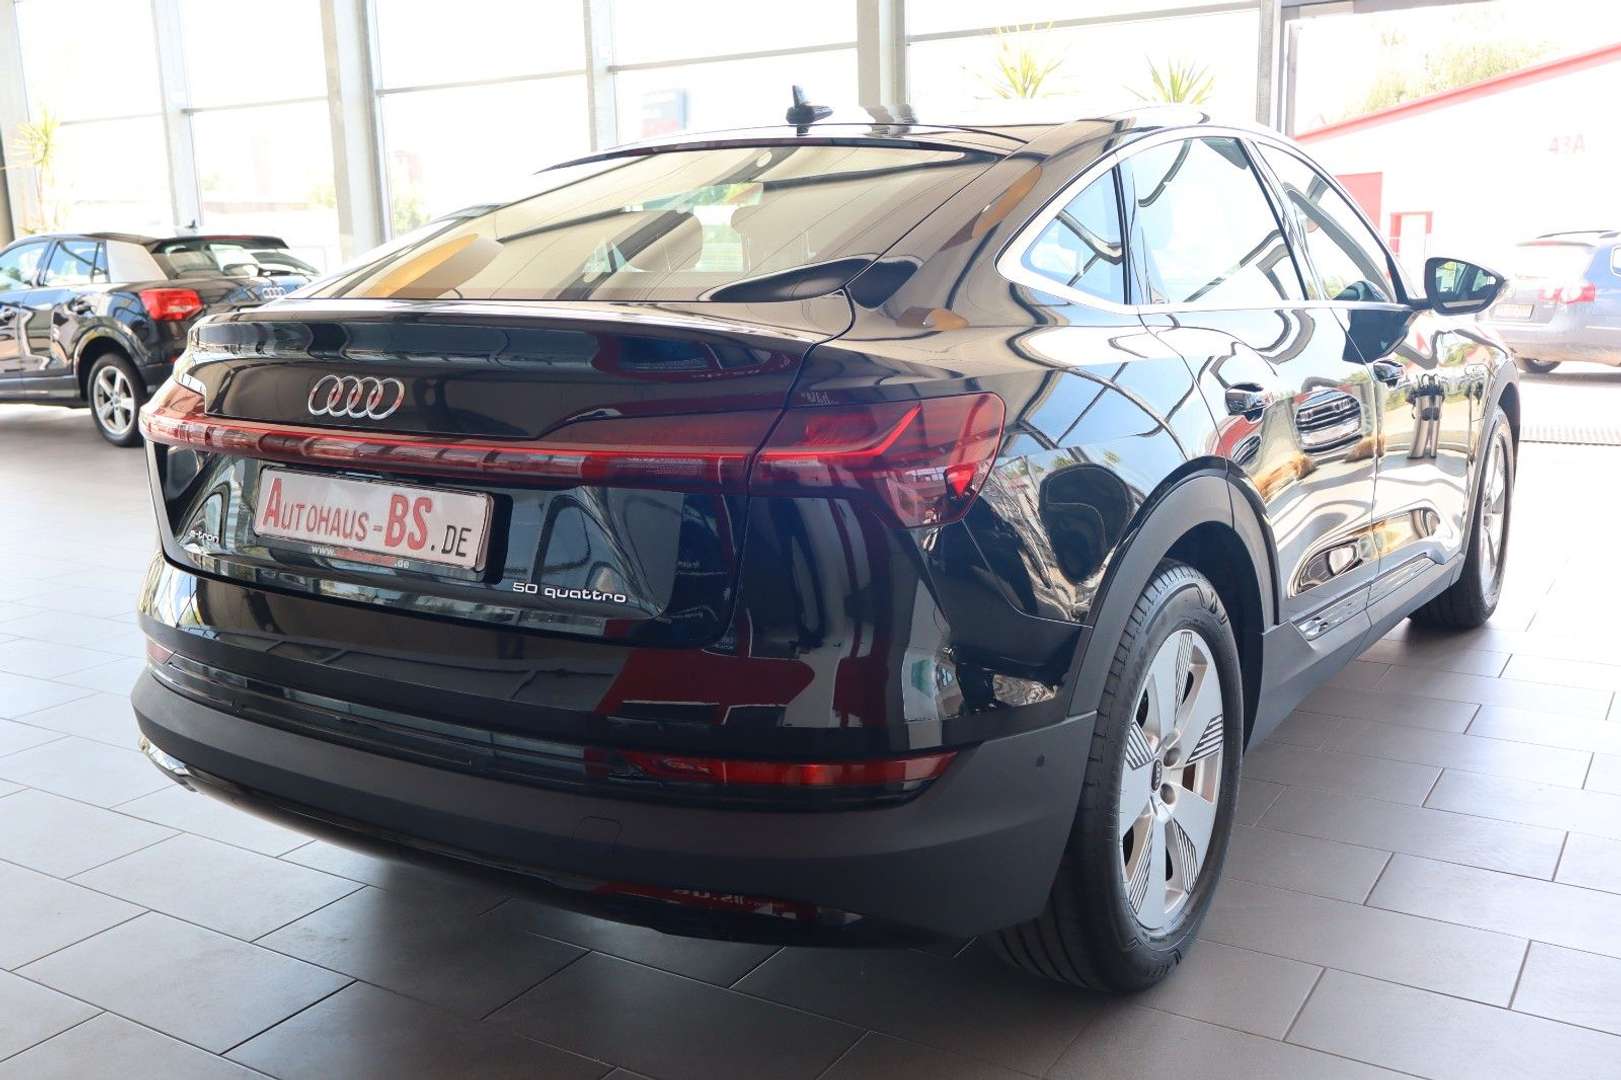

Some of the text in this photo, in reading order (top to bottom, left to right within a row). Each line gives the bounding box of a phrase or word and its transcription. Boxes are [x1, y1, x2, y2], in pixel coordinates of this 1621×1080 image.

[189, 529, 219, 544] e-tron
[512, 581, 627, 603] 50 quattro
